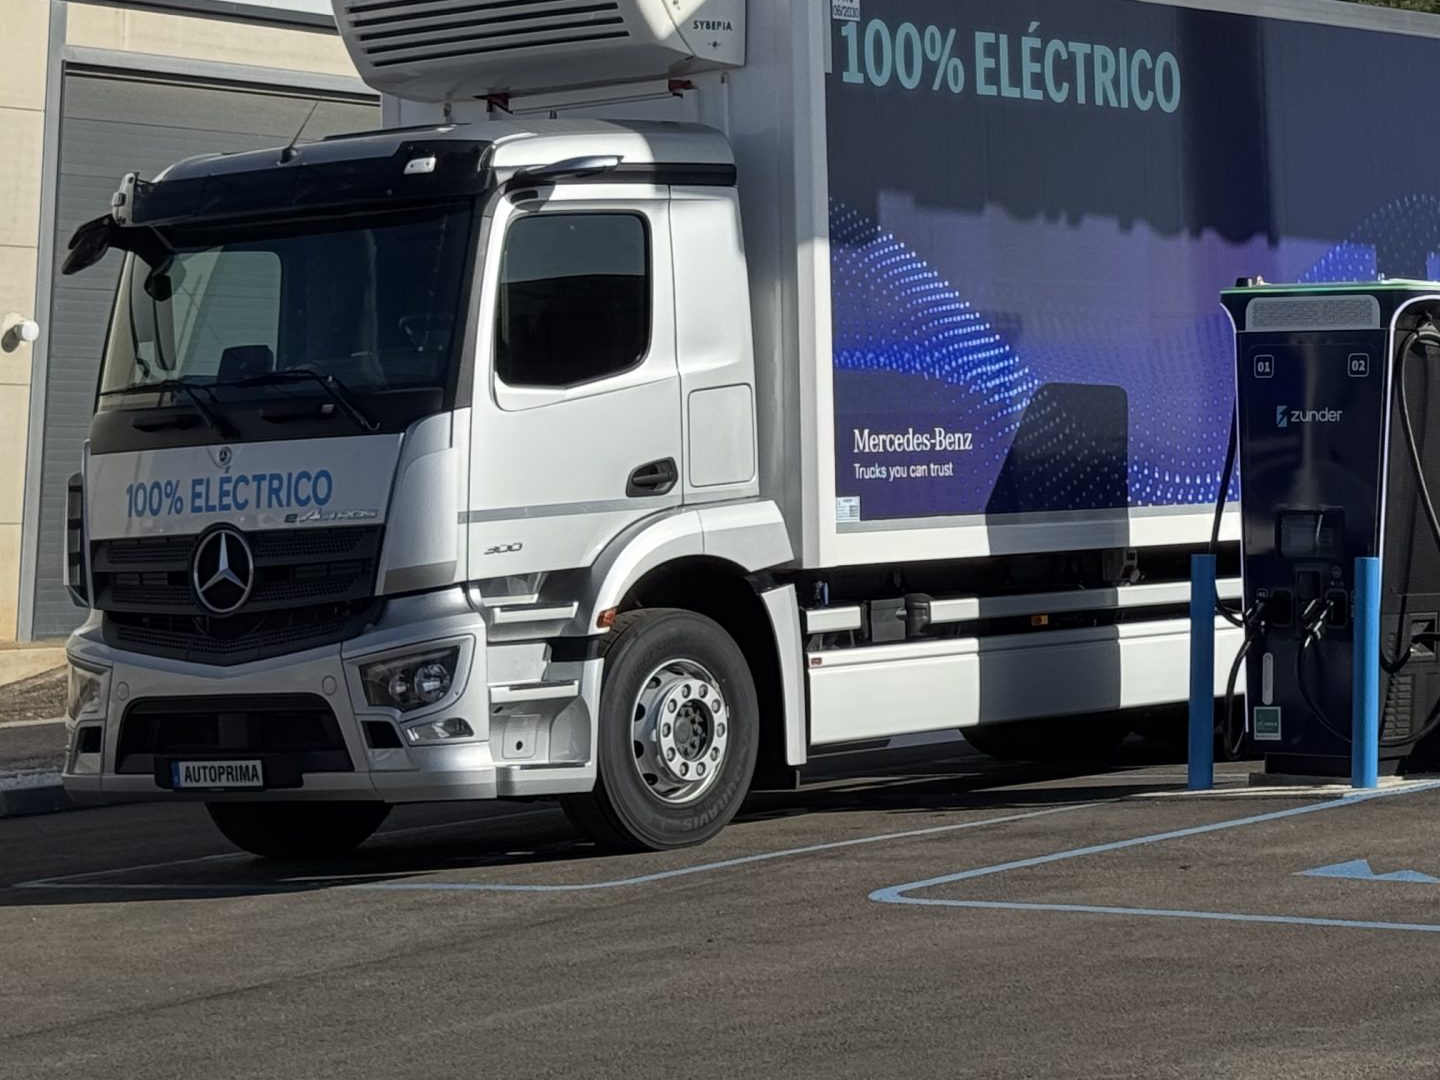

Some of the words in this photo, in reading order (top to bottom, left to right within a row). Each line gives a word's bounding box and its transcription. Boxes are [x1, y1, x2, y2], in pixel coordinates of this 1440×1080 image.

[841, 18, 965, 94] 100%
[974, 21, 1182, 113] ELÉCTRICO
[1257, 361, 1271, 372] 01
[1351, 360, 1366, 371] 02
[1290, 407, 1343, 422] zunder
[853, 427, 973, 453] Mercedes-Benz
[853, 462, 887, 480] Trucks
[889, 466, 908, 482] you
[909, 465, 929, 477] can
[929, 462, 954, 477] trust
[126, 479, 184, 519] 100%
[190, 466, 333, 514] ELÉCTRICO
[184, 764, 260, 783] AUTOPRIMA
